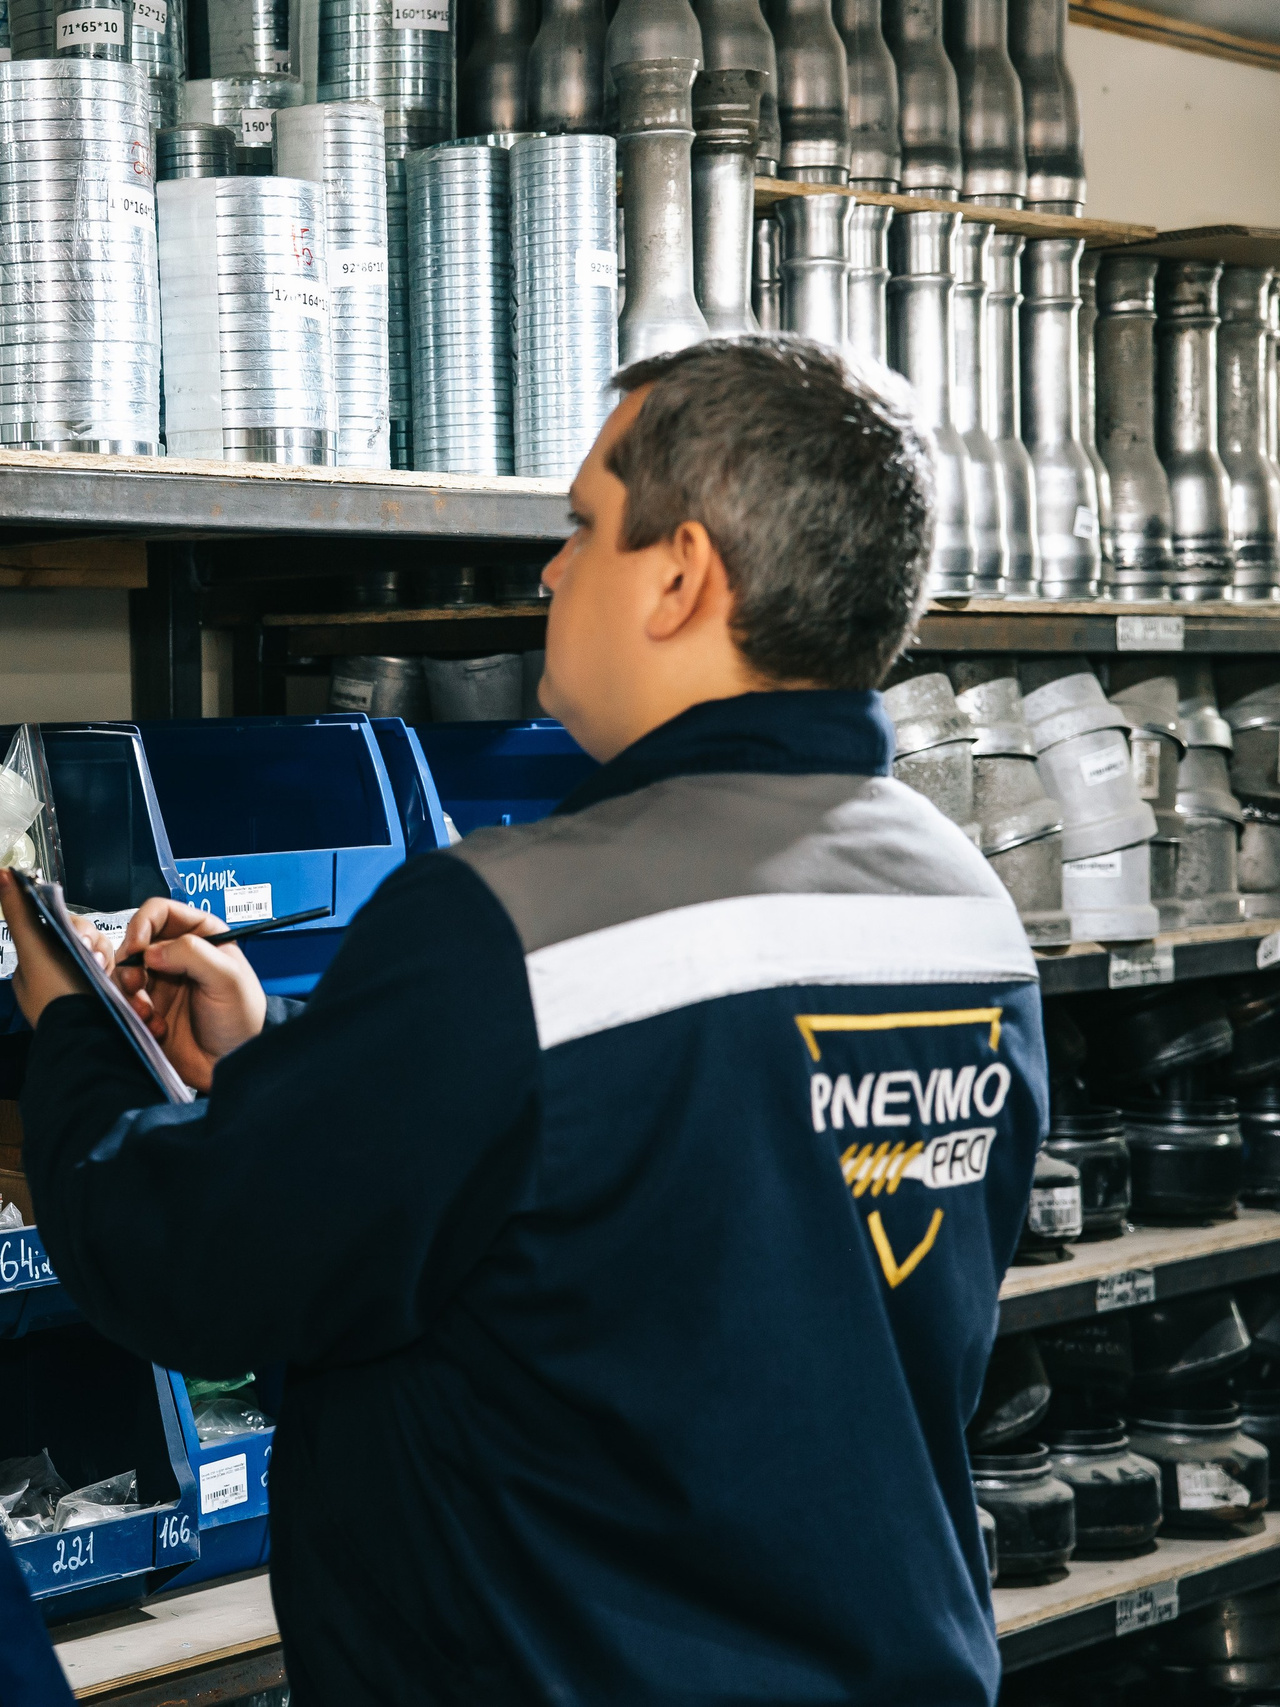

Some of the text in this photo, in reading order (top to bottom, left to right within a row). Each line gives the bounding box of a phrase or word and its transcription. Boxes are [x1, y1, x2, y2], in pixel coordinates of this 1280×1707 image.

[810, 1061, 1011, 1133] PNEVMO
[931, 1134, 987, 1184] PRO
[52, 1531, 94, 1574] 221
[159, 1514, 191, 1548] 166
